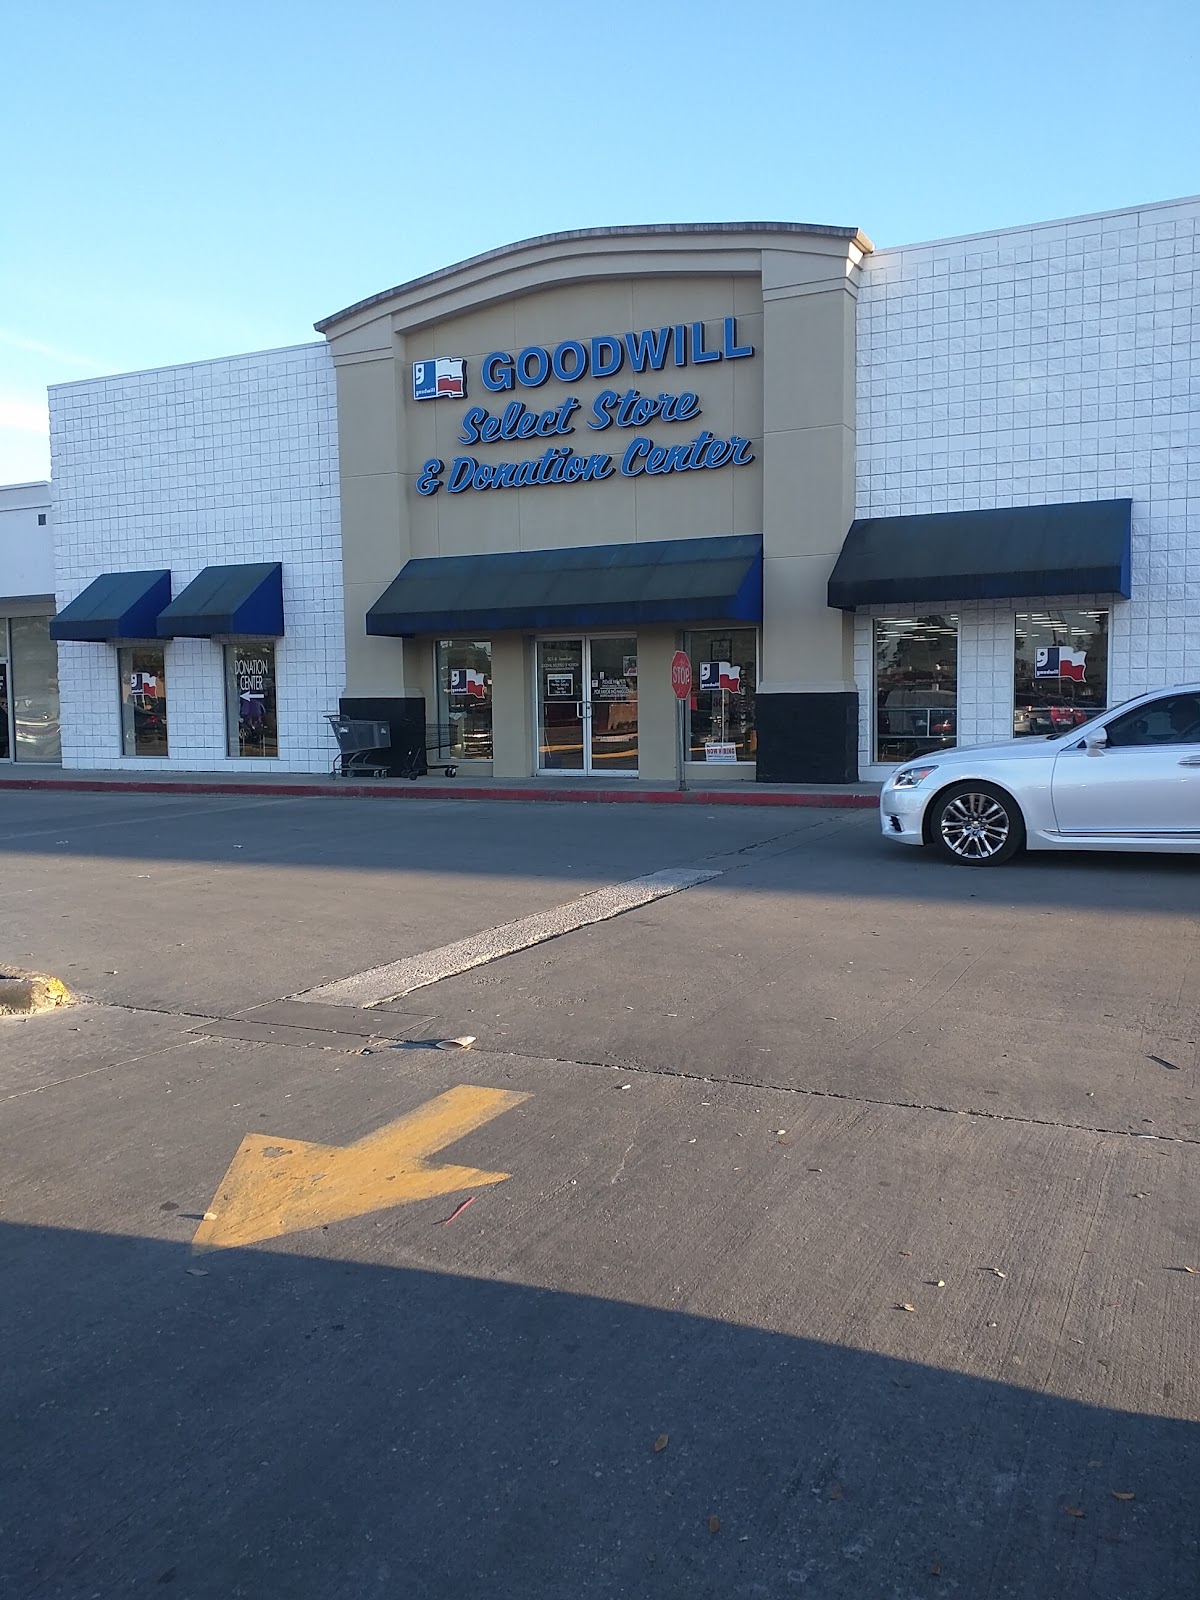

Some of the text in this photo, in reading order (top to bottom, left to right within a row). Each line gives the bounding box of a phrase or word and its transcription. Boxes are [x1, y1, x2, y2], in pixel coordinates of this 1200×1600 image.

[481, 316, 755, 392] GOODWILL
[457, 388, 702, 446] Select Store
[416, 430, 755, 496] & Donation Center
[234, 659, 268, 675] DONATION
[240, 675, 263, 690] CENTER
[672, 666, 690, 684] STOP
